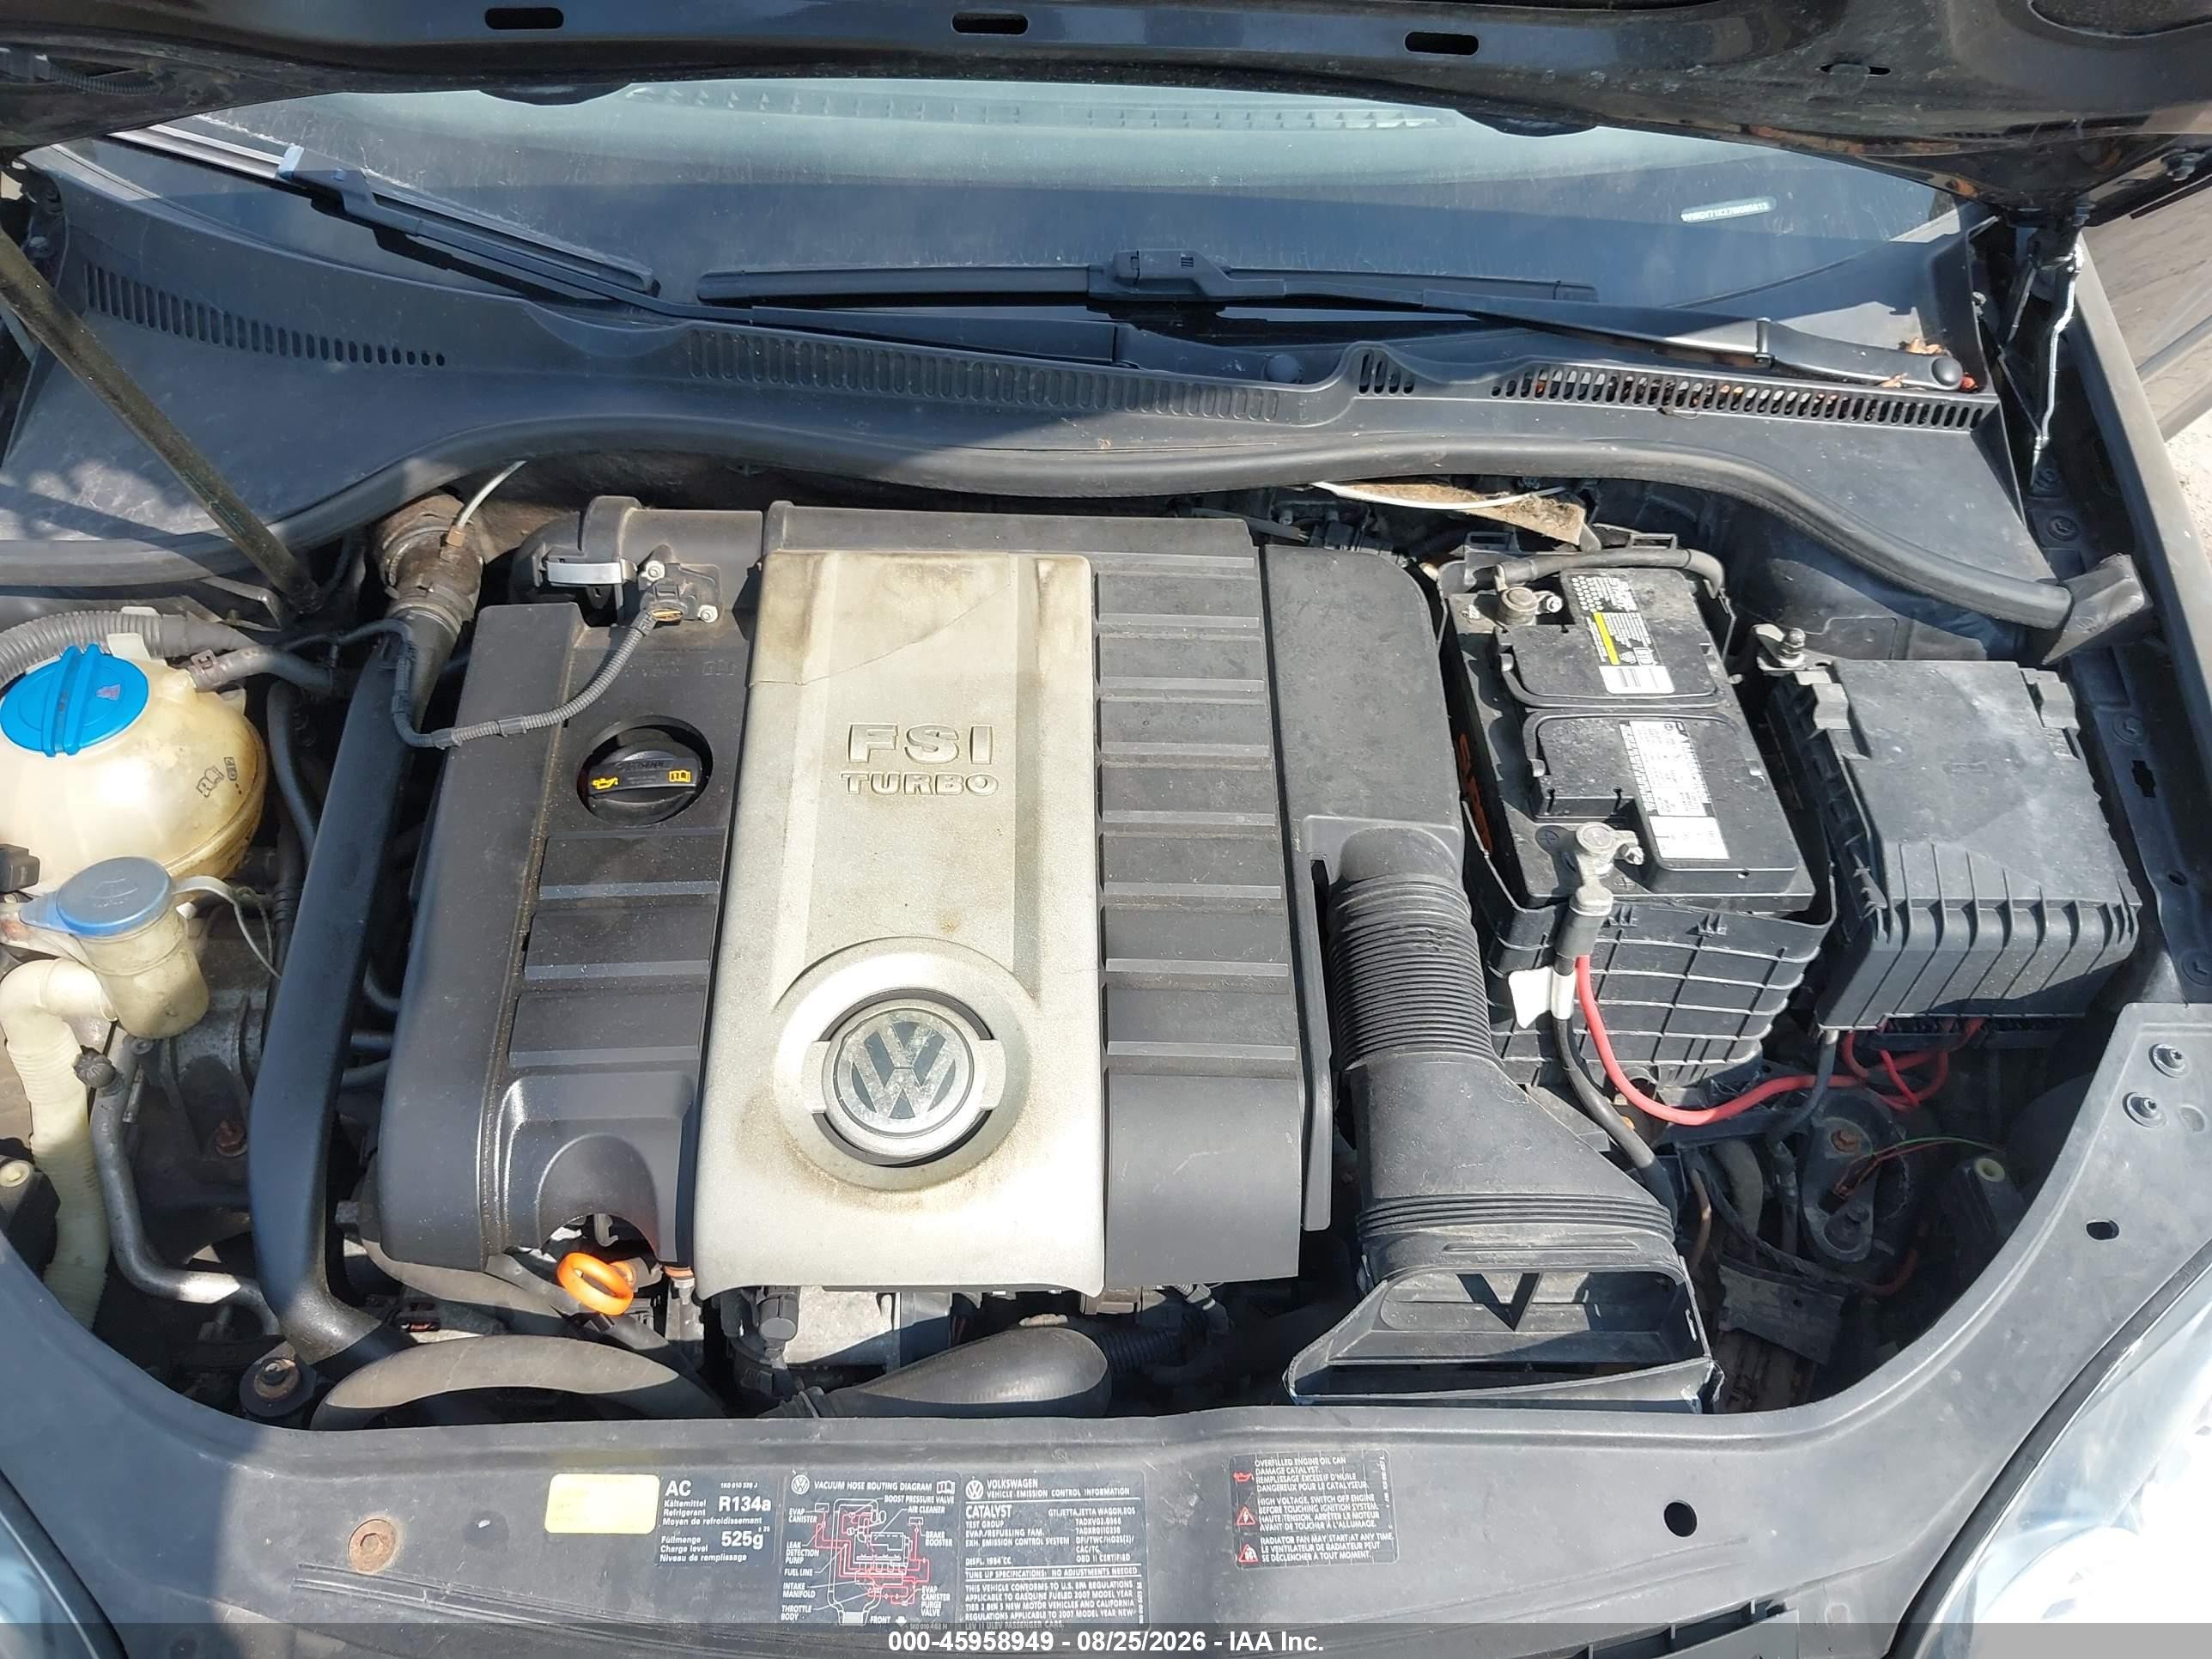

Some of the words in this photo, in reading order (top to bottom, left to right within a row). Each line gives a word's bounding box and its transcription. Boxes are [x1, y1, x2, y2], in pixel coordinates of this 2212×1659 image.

[847, 723, 995, 765] FSI
[841, 771, 999, 796] TURBO
[1255, 1467, 1285, 1475] DAMAGE
[1286, 1466, 1321, 1474] CATALYST.
[987, 1479, 1038, 1489] VOLKSWAGEN
[1256, 1475, 1299, 1484] REMPLISSAGE
[1302, 1474, 1328, 1482] EXCESSIF
[665, 1480, 691, 1496] AC
[847, 1481, 865, 1490] HOSE
[900, 1482, 932, 1491] DIAGRAM
[1257, 1483, 1297, 1492] DANGEREUX
[1085, 1487, 1129, 1496] INFORMATION
[1351, 1493, 1374, 1502] ENGINE
[719, 1496, 771, 1511] R134a
[1259, 1505, 1282, 1514] BEFORE
[1284, 1504, 1318, 1513] TOUCHING
[1321, 1503, 1350, 1511] IGNITION
[664, 1509, 705, 1517] Refrigerant
[966, 1504, 1012, 1519] CATALYST
[663, 1517, 689, 1526] Moyen
[703, 1516, 763, 1525] refroidissement
[788, 1515, 817, 1523] CANISTER
[1260, 1523, 1282, 1532] AVANT
[661, 1535, 701, 1544] Füllmenge
[721, 1531, 763, 1550] 525g
[982, 1538, 1012, 1547] EMISSION
[1015, 1537, 1043, 1546] CONTROL
[1046, 1537, 1070, 1546] SYSTEM
[1261, 1535, 1295, 1545] RADIATOR
[1329, 1534, 1348, 1542] START
[1270, 1544, 1315, 1553] VENTILATEUR
[1326, 1541, 1363, 1551] RADIATEUR
[701, 1553, 747, 1562] remplissage
[1320, 1552, 1338, 1560] TOUT
[965, 1584, 980, 1593] THIS
[1011, 1583, 1048, 1591] CONFORMS
[1089, 1580, 1133, 1589] REGULATIONS
[965, 1593, 1002, 1601] APPLICABLE
[1015, 1592, 1047, 1601] GASOLINE
[921, 1601, 941, 1609] PURGE
[1097, 1599, 1134, 1607] CALIFORNIA
[1011, 1611, 1046, 1620] APPLICABLE
